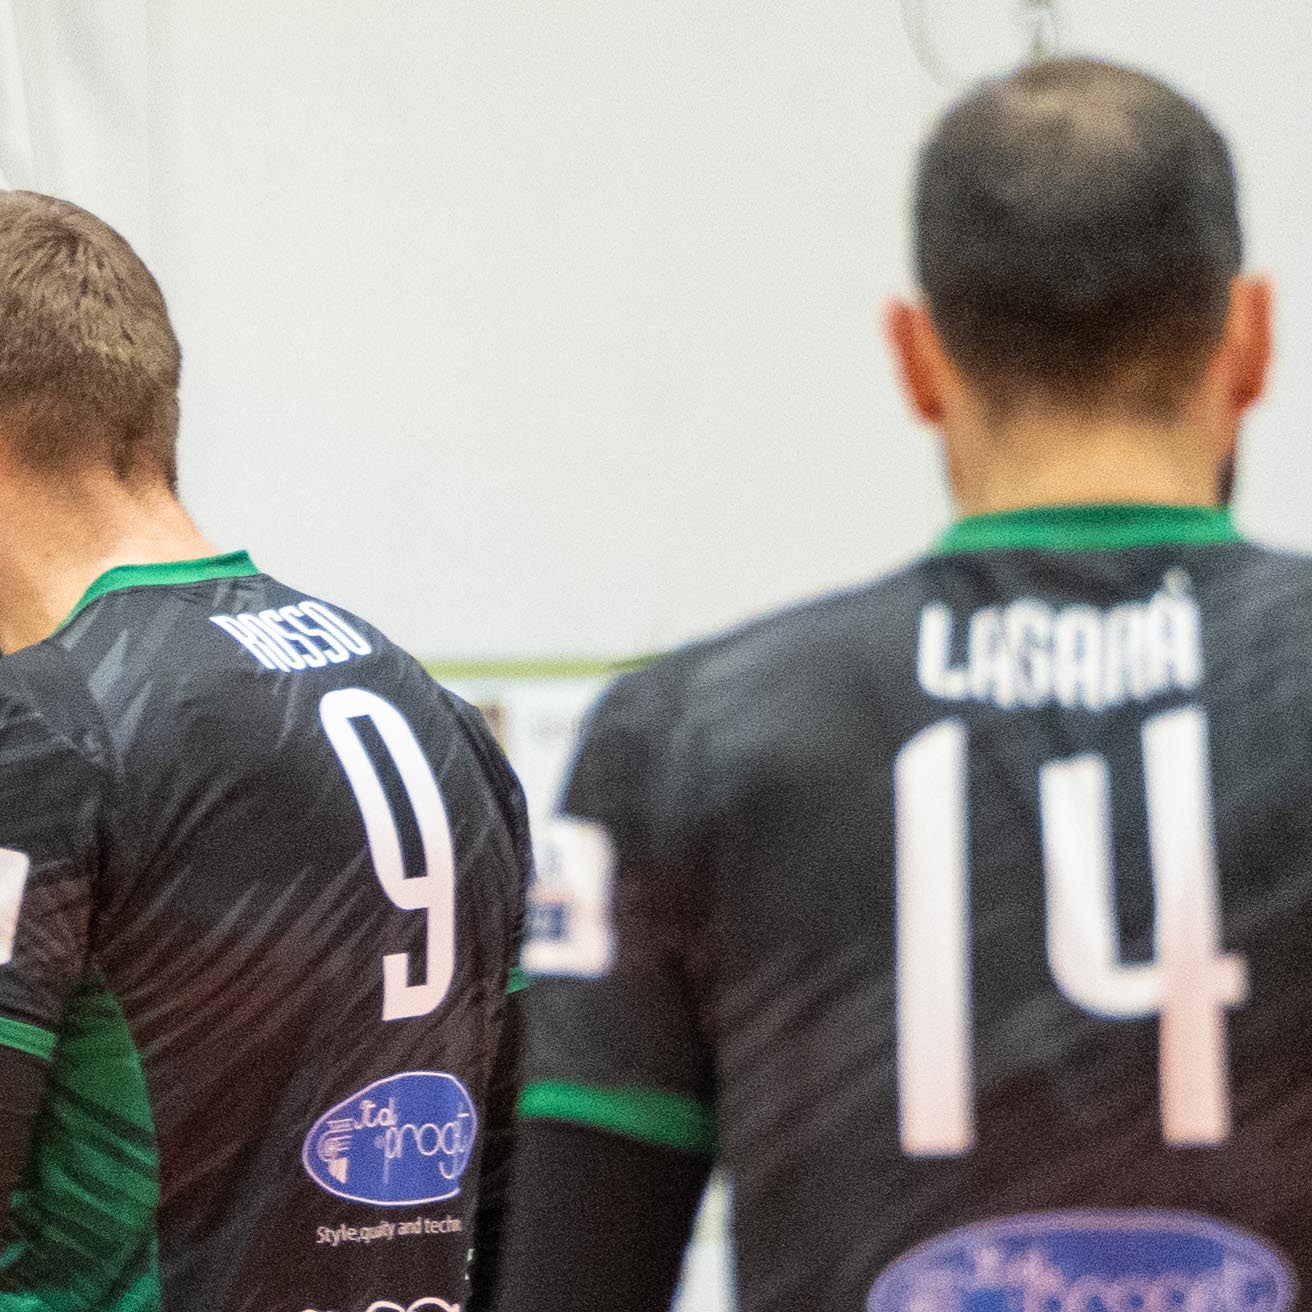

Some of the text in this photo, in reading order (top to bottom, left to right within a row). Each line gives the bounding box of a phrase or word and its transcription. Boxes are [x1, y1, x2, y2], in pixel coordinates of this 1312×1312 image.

[208, 600, 372, 673] ROSSO
[318, 687, 456, 1022] 9
[894, 704, 1251, 1159] 14
